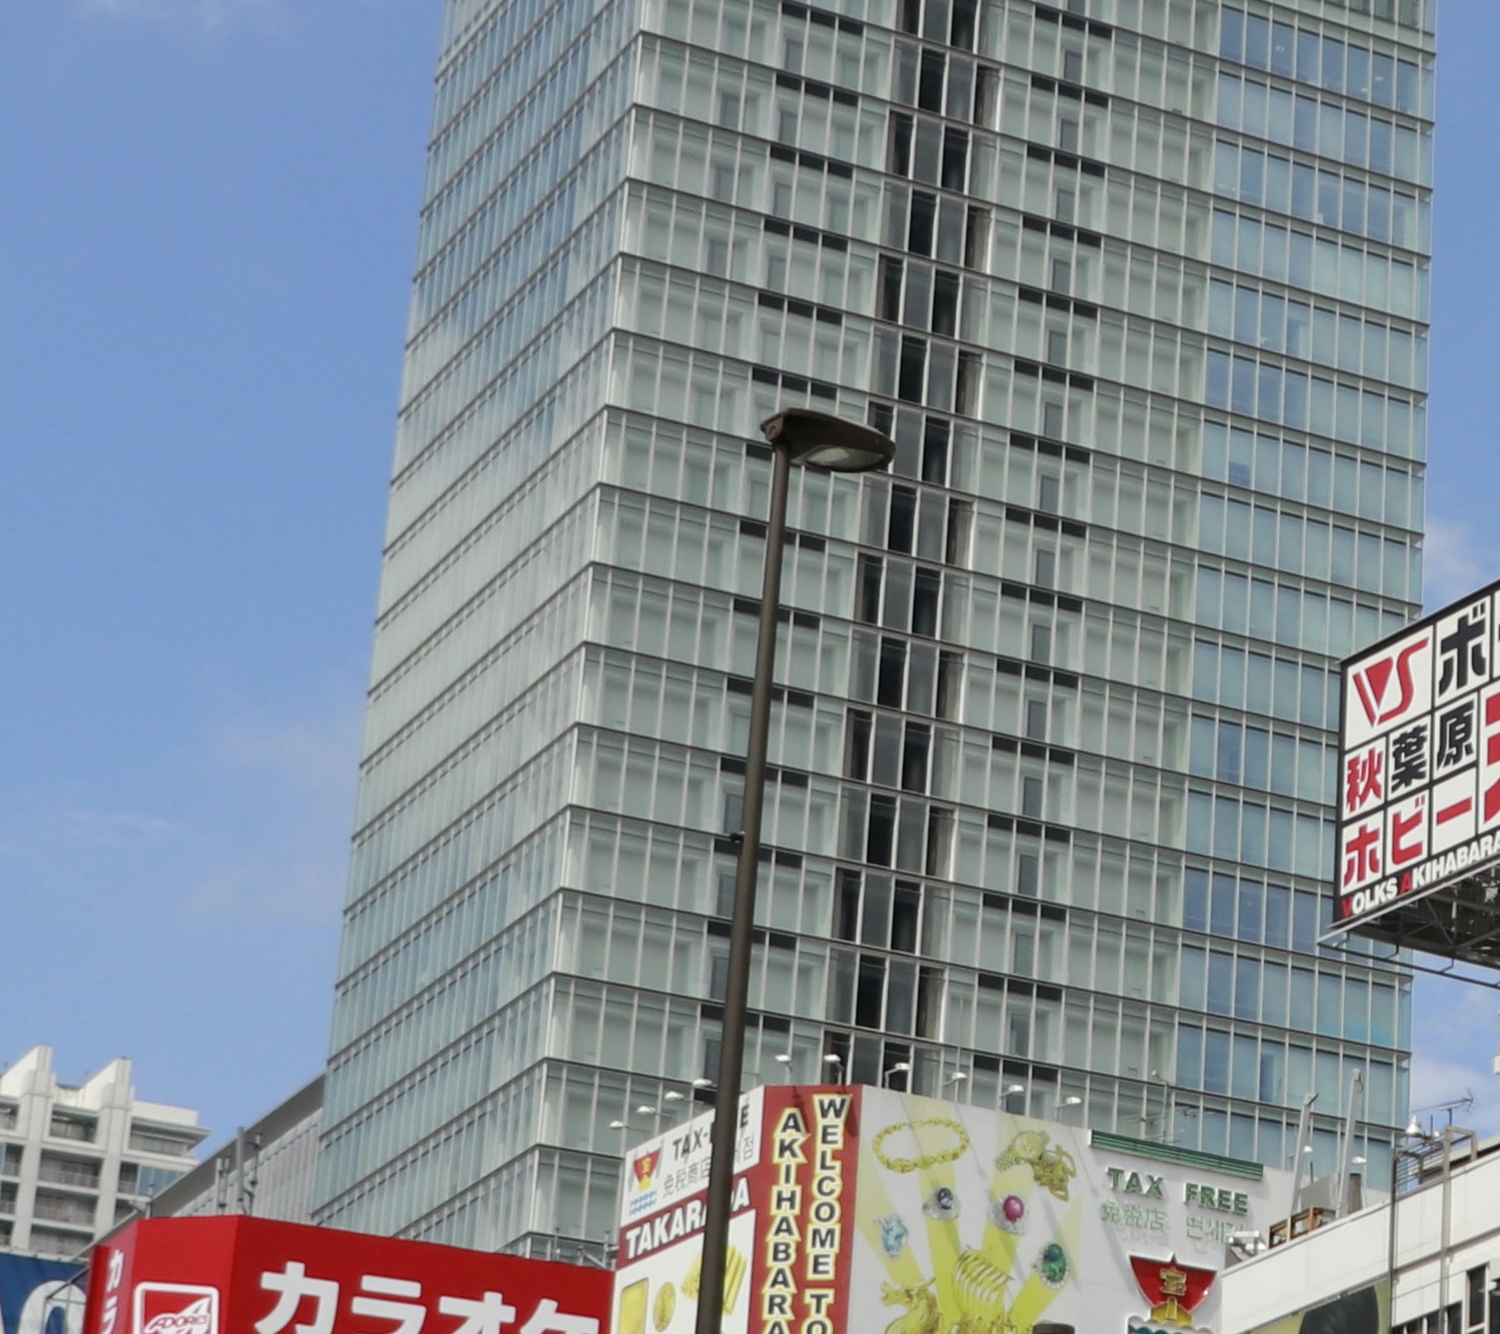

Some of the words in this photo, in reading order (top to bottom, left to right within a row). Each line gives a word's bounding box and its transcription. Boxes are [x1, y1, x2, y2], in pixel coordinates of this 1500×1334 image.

[1346, 697, 1478, 815] 秋葉原
[1342, 881, 1400, 919] VOLKS
[810, 1097, 851, 1276] WELCOME
[1107, 1167, 1164, 1198] TAX
[1184, 1183, 1249, 1215] FREE
